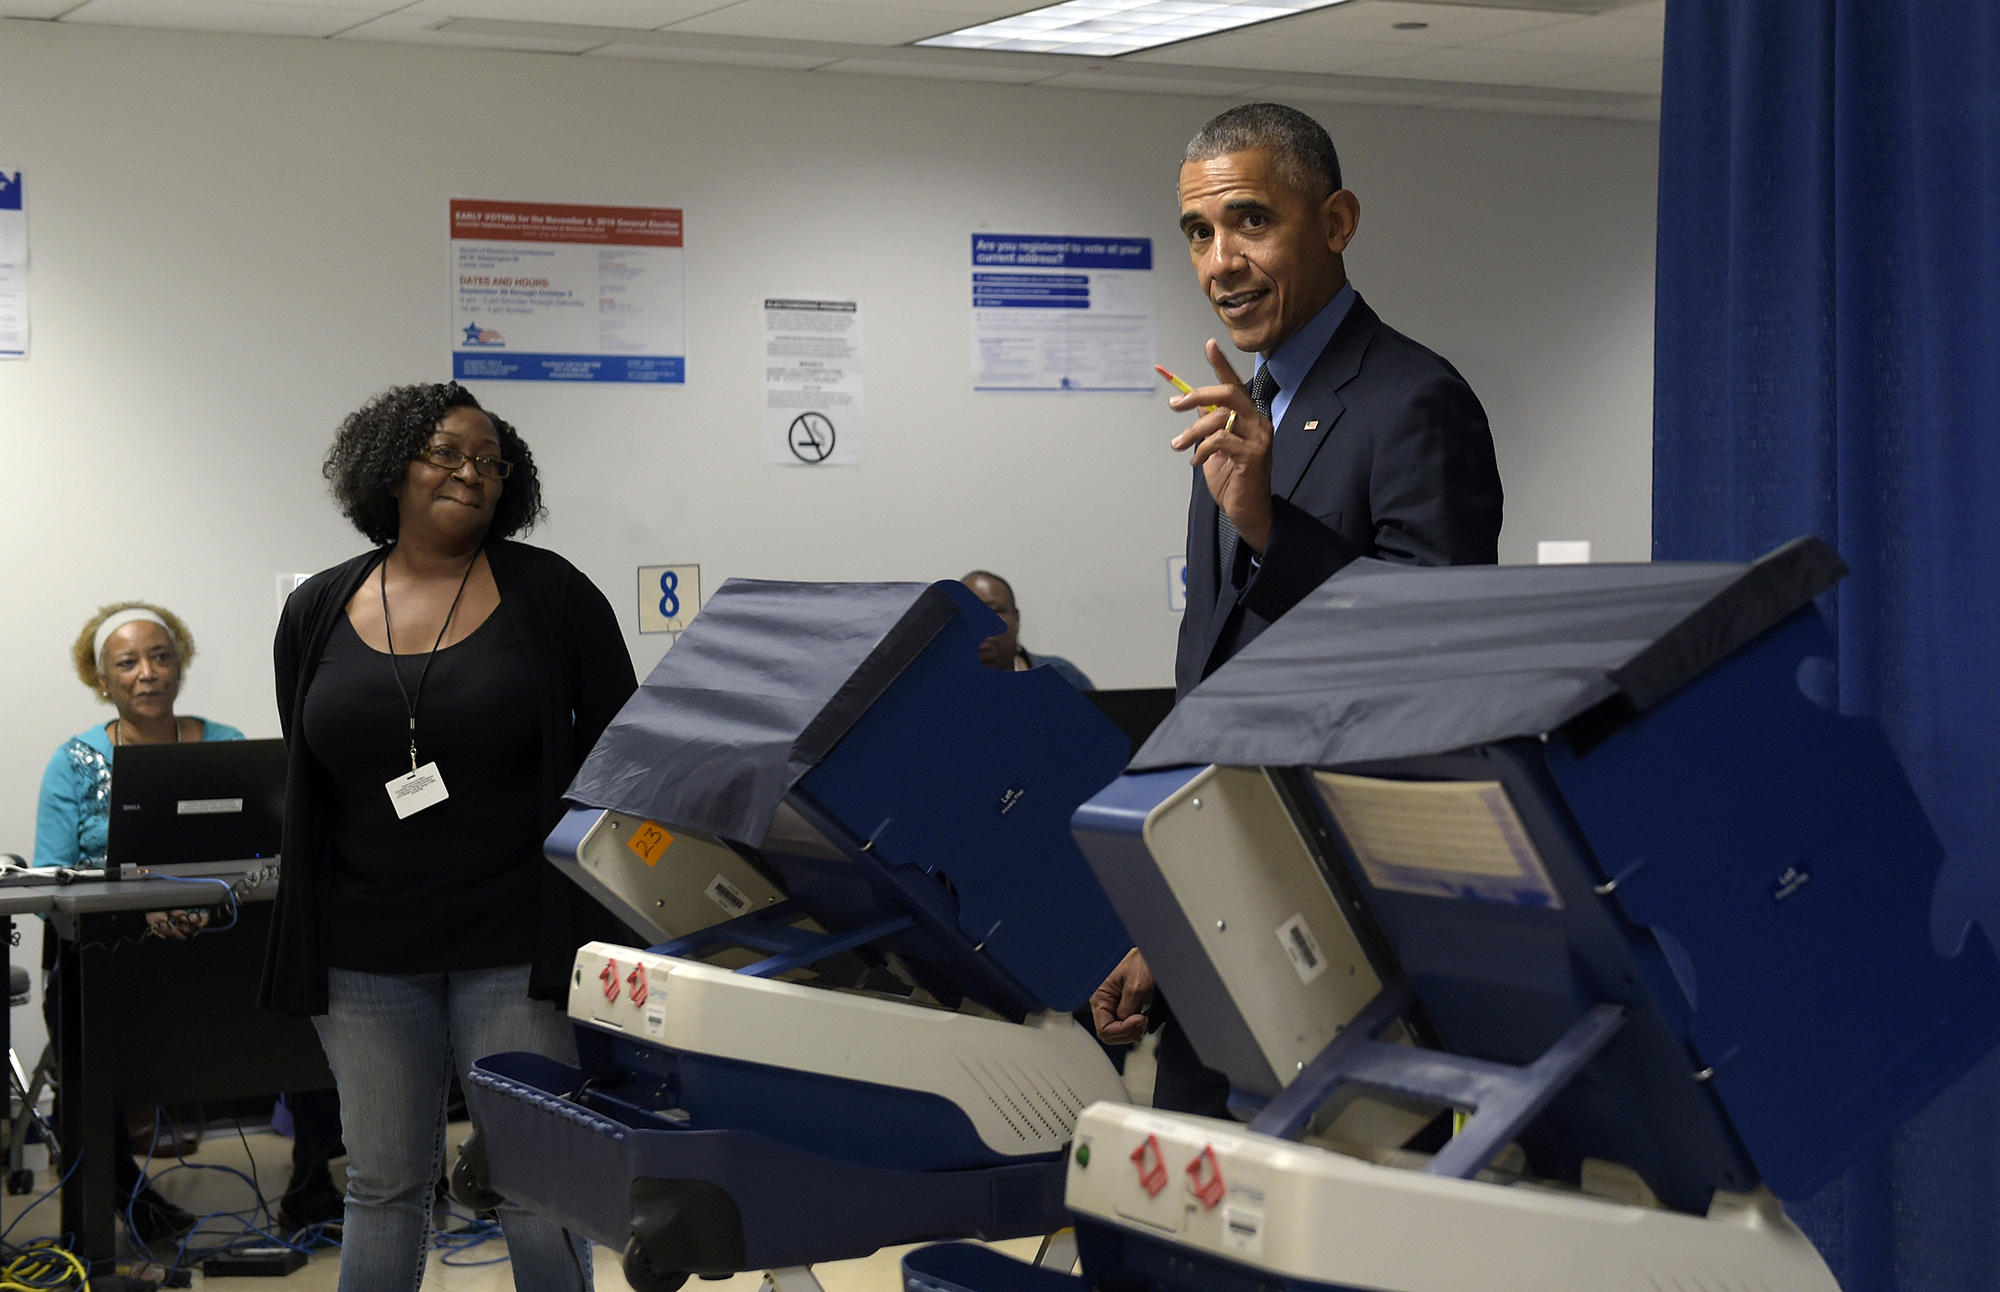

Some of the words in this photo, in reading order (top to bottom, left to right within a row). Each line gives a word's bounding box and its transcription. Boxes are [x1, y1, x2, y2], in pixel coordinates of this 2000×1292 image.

[485, 212, 516, 223] VOTING
[976, 239, 995, 251] Are
[997, 241, 1017, 253] you
[1018, 240, 1070, 254] registered
[1071, 242, 1082, 253] to
[1083, 243, 1106, 254] vote
[1107, 243, 1119, 254] at
[1120, 245, 1143, 256] your
[976, 253, 1016, 263] current
[1017, 253, 1065, 265] address?
[460, 275, 490, 286] DATES
[492, 276, 513, 287] AND
[659, 571, 679, 617] 8
[635, 828, 662, 858] 23
